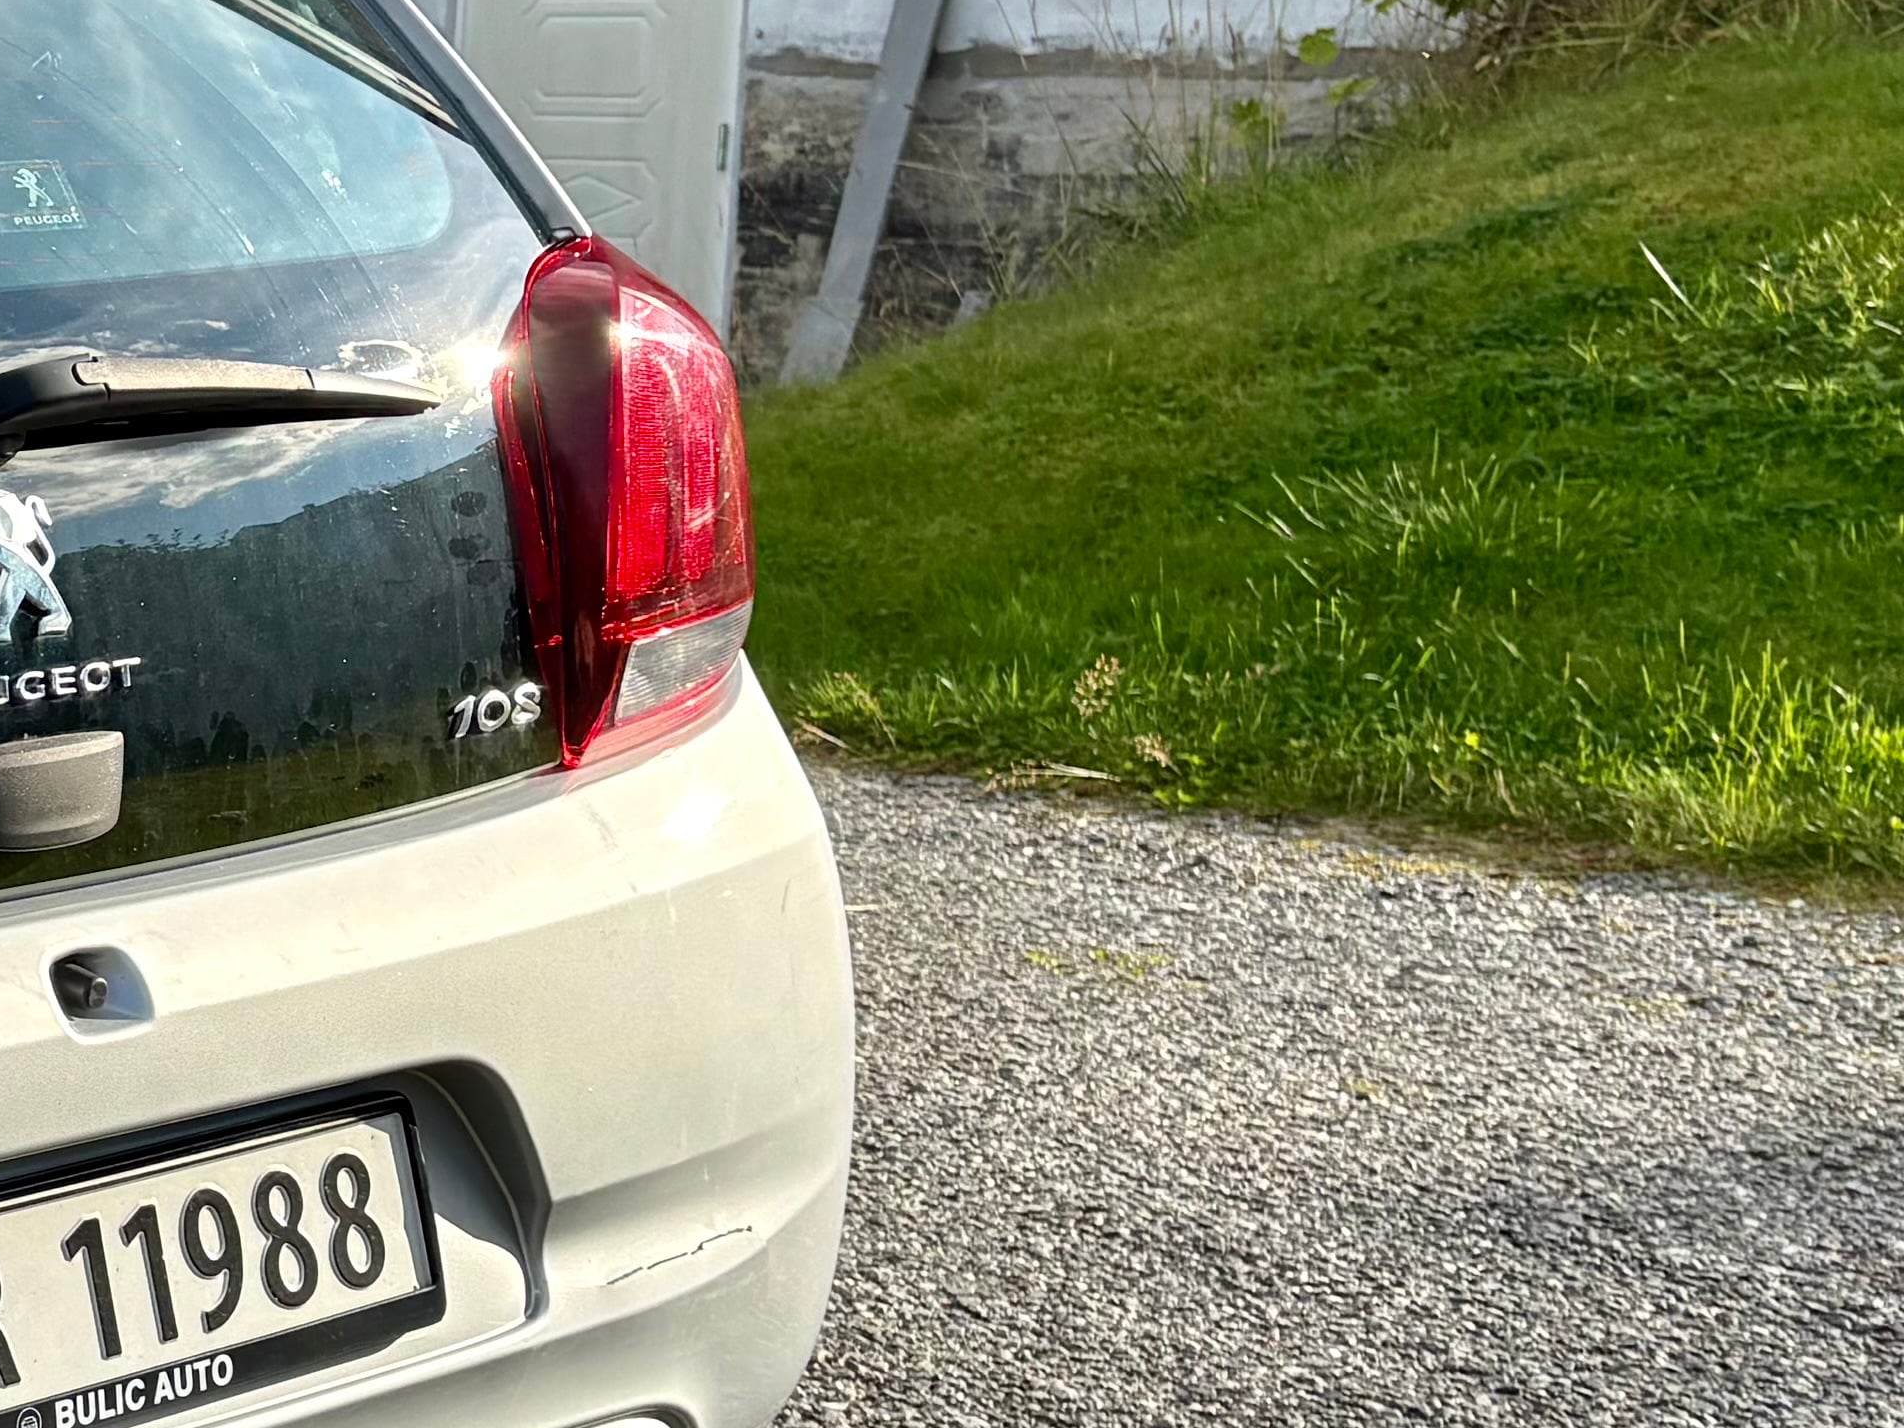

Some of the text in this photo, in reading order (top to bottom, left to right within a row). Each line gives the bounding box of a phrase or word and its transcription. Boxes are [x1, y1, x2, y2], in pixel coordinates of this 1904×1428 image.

[14, 213, 80, 226] PEUGEOT
[448, 682, 541, 738] 108
[61, 1153, 386, 1361] 11988
[154, 1354, 234, 1405] AUTO
